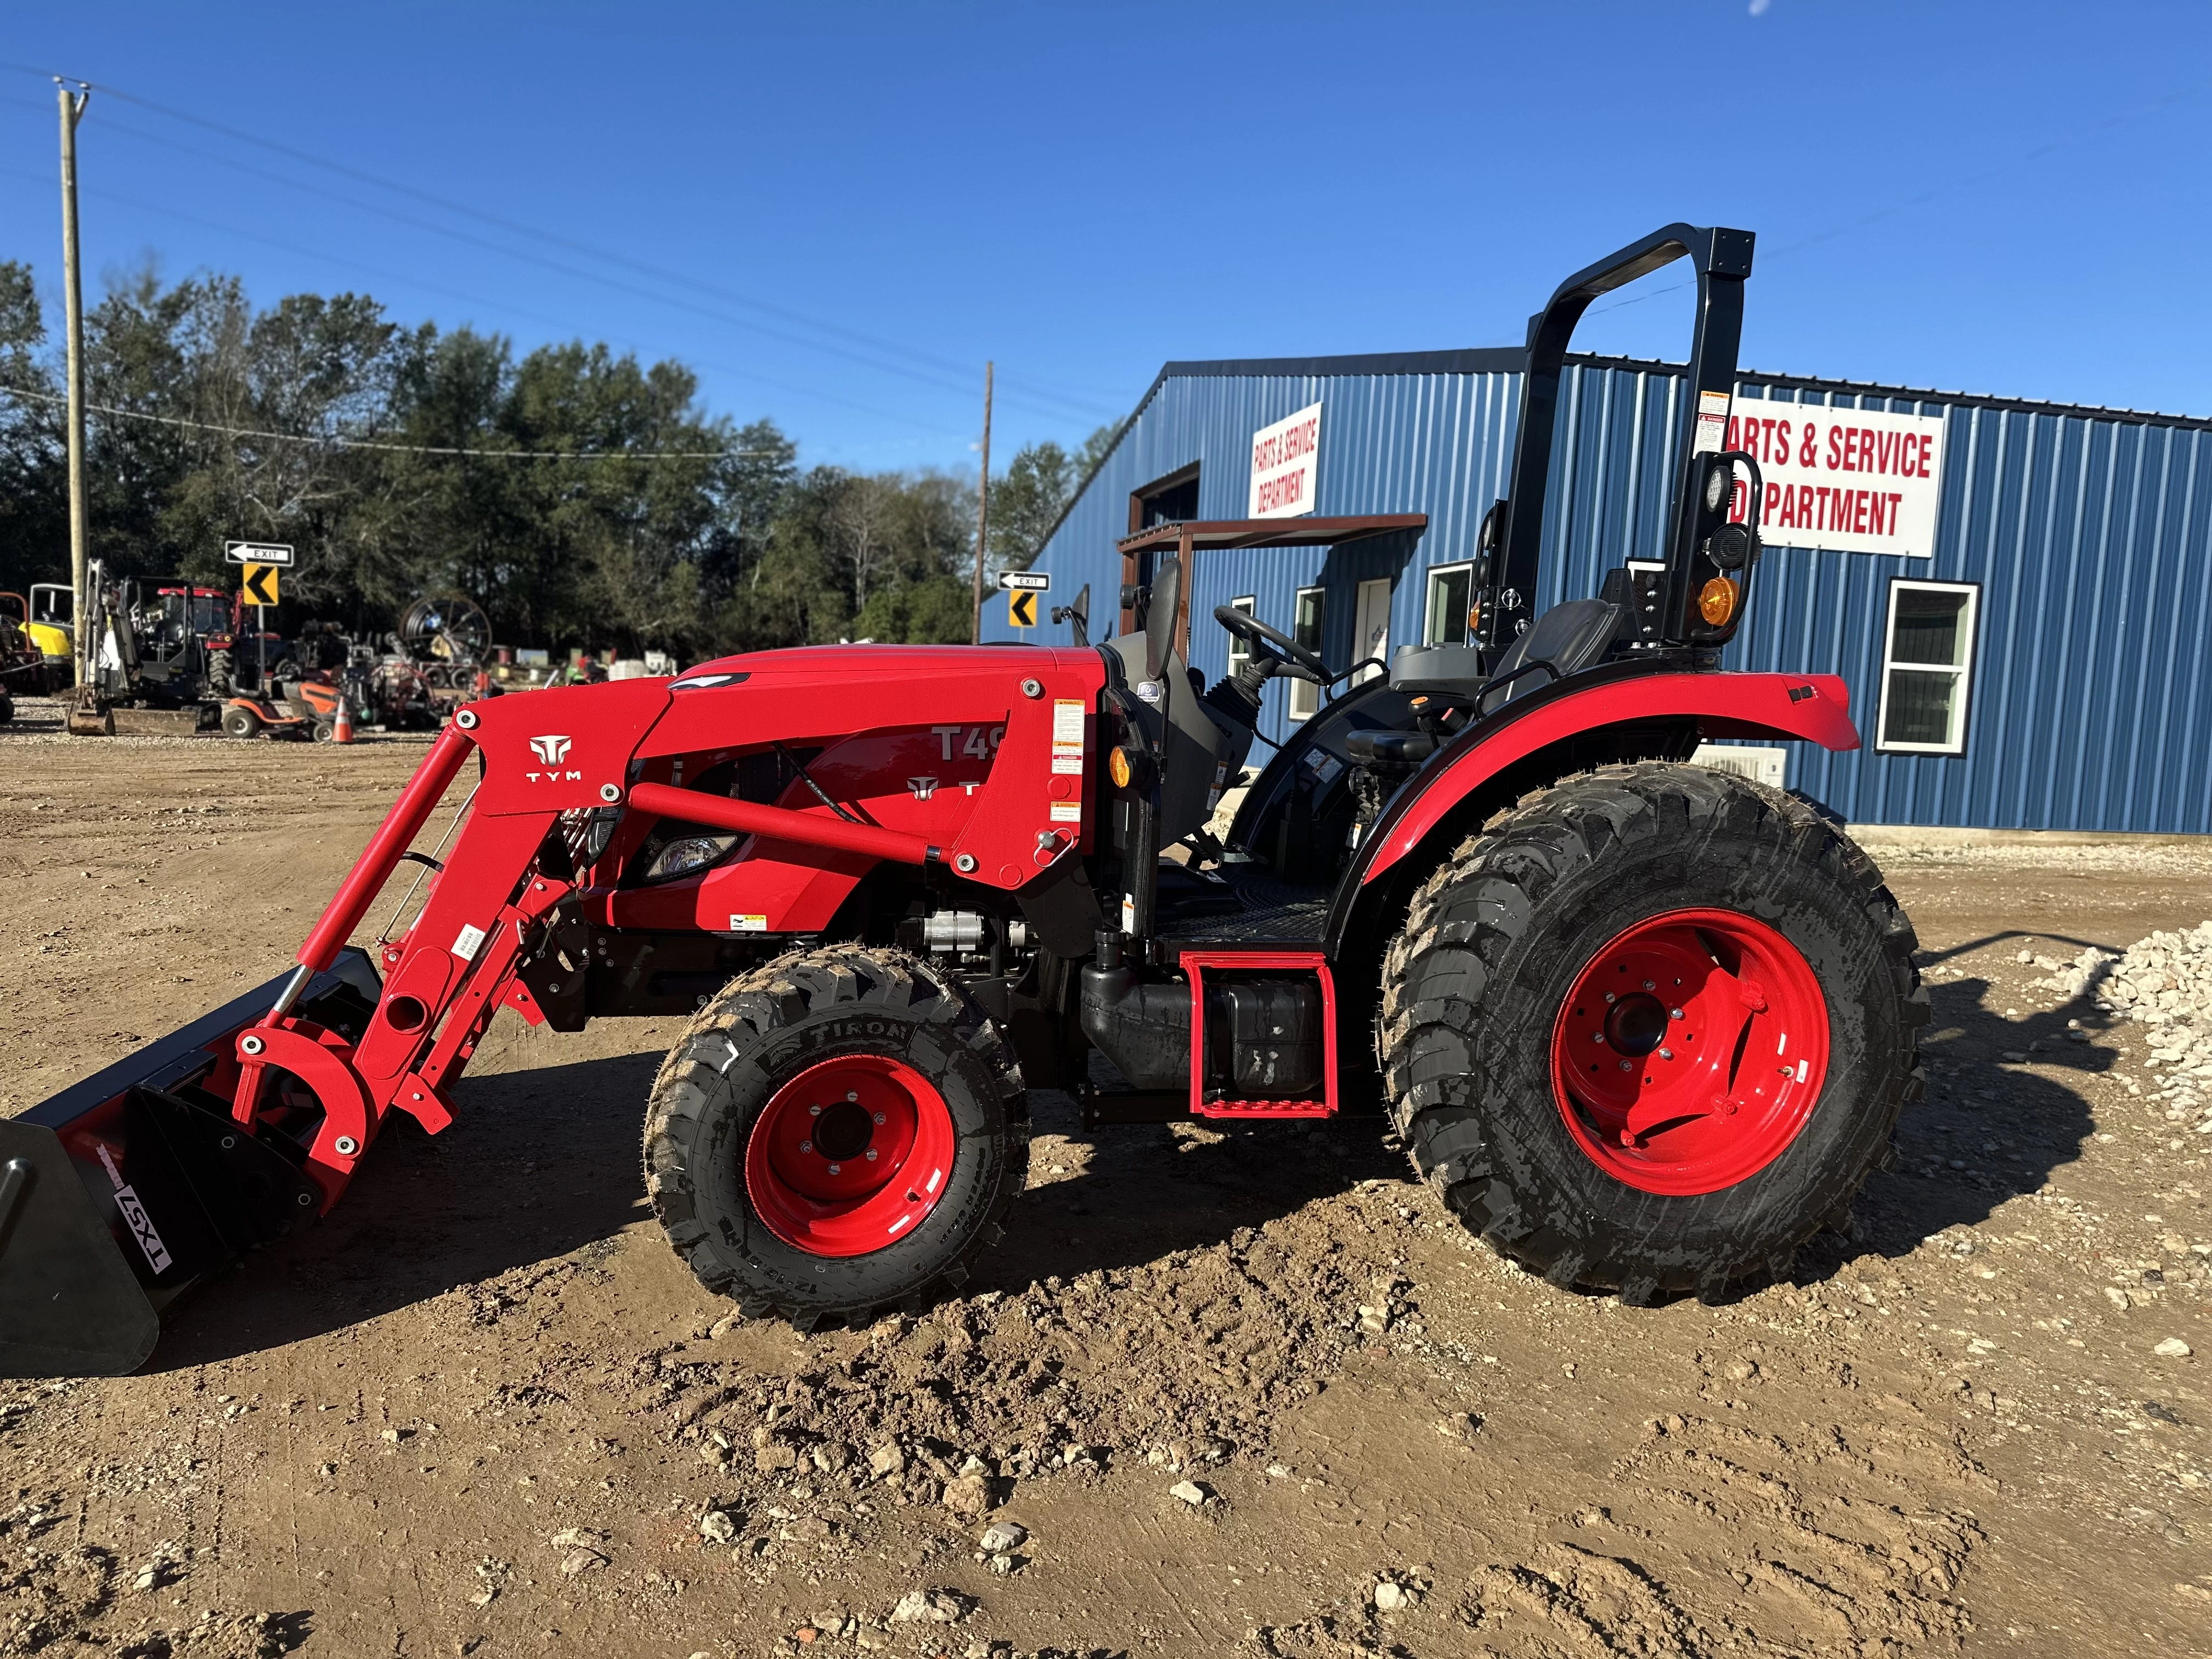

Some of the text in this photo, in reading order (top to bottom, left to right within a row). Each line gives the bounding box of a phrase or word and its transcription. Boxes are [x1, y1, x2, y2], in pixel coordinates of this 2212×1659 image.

[1254, 417, 1317, 475] PARTS & SERVICE
[1726, 415, 1791, 465] ARTS
[1799, 422, 1817, 468] &
[1826, 425, 1933, 478] SERVICE
[1258, 467, 1305, 514] DEPARTMENT
[1729, 479, 1902, 536] DPARTMENT
[254, 550, 278, 558] EXIT
[526, 770, 582, 783] TYM
[810, 1022, 908, 1041] TIRON
[119, 1196, 164, 1267] TX57
